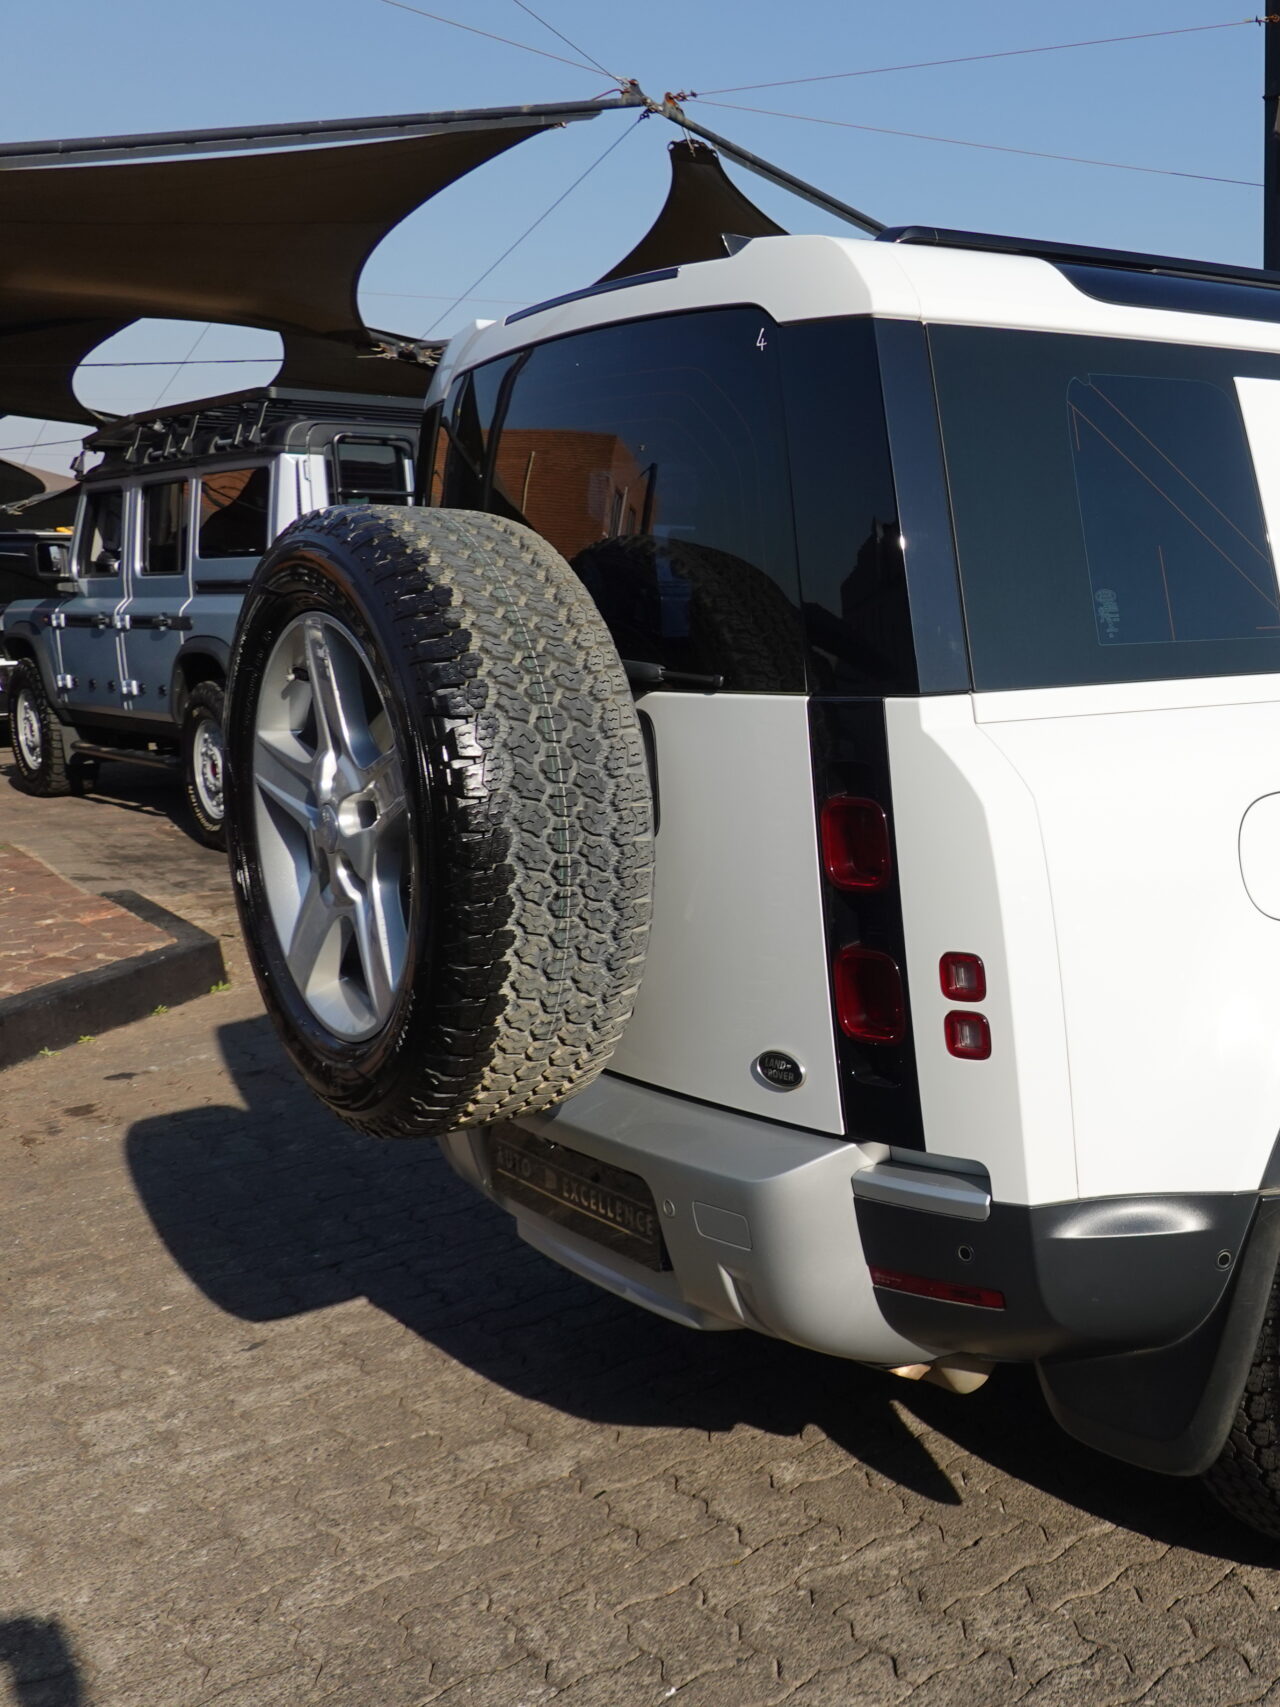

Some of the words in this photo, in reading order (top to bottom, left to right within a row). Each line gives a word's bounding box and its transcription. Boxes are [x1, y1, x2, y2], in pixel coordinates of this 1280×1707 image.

[756, 327, 768, 351] 4
[764, 1056, 787, 1070] LAND
[767, 1069, 795, 1081] ROVER
[496, 1146, 532, 1178] AUTO
[561, 1177, 654, 1237] EXCELLENCE
